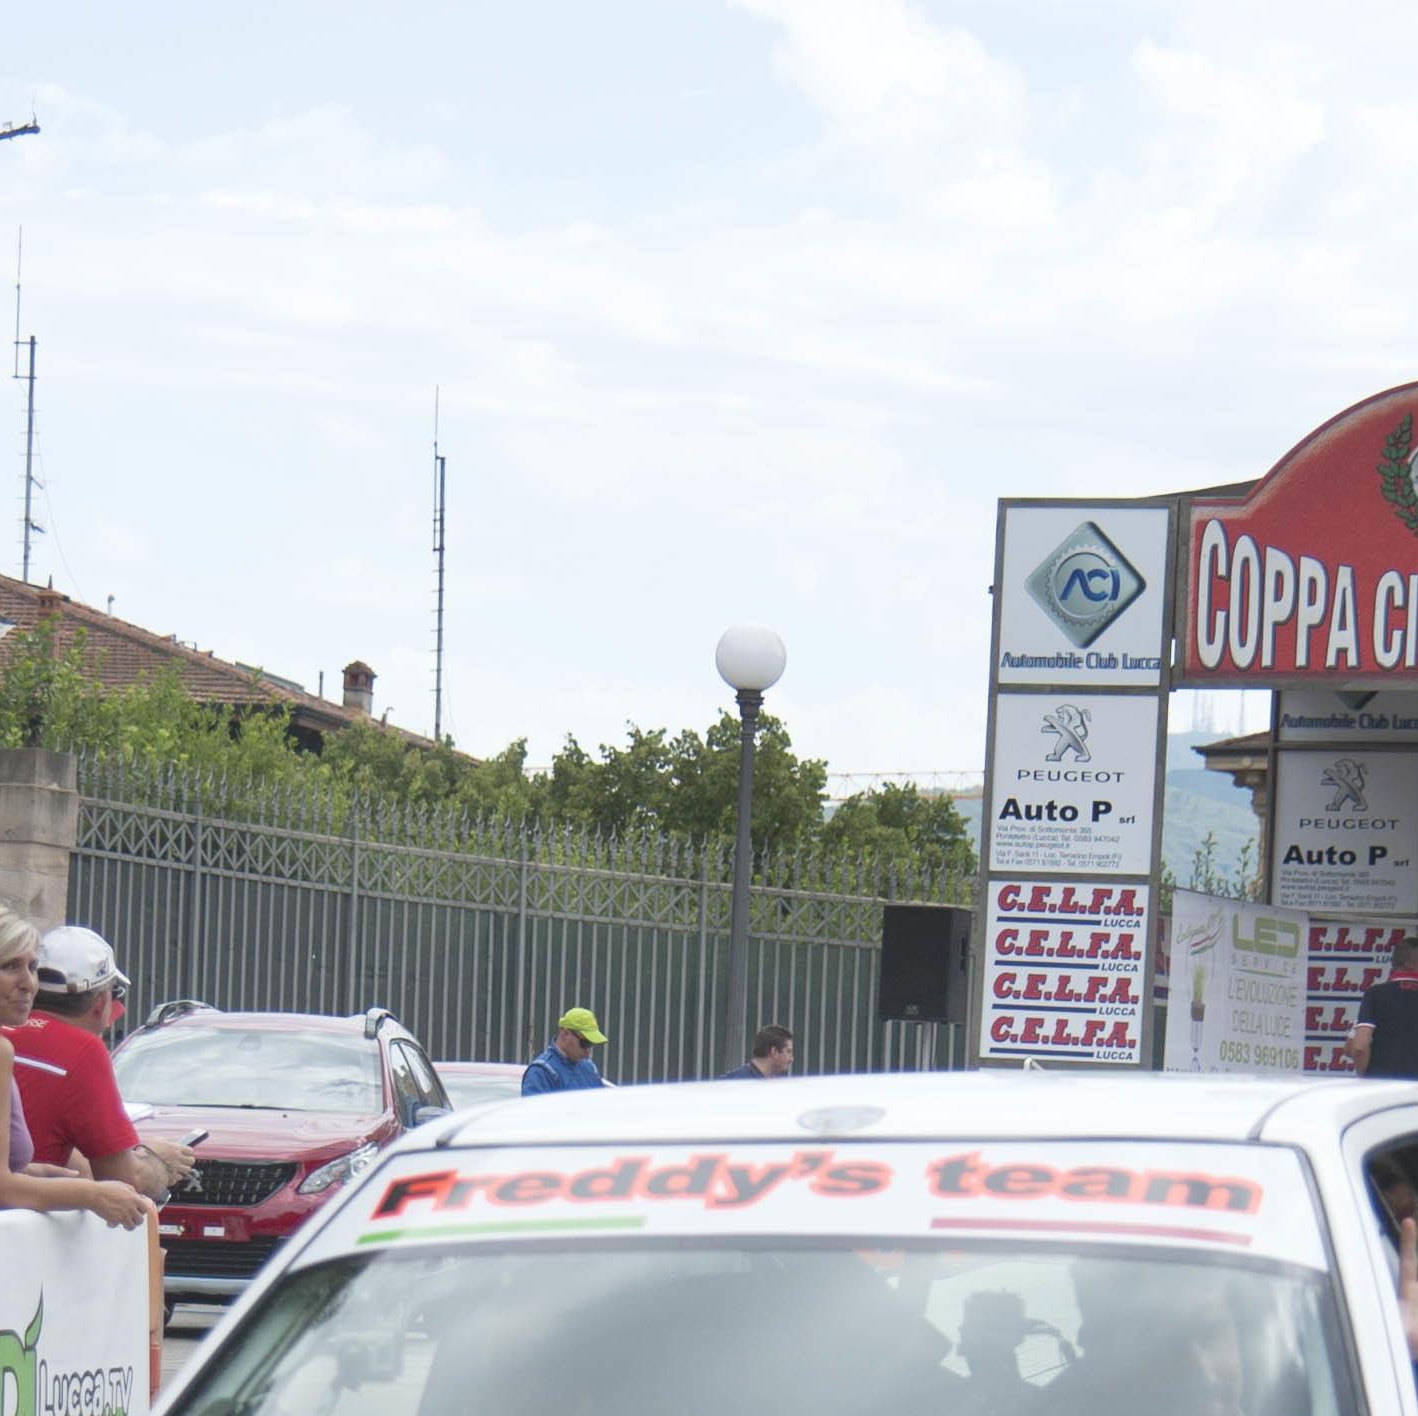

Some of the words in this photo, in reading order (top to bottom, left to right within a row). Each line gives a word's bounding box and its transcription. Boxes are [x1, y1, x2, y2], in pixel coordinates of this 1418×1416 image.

[1058, 567, 1121, 603] ACI
[1196, 518, 1361, 671] COPPA
[1000, 651, 1083, 671] Automobile
[1085, 651, 1119, 671] Club
[1121, 652, 1162, 671] Lucca
[1280, 713, 1356, 730] Automobile
[1358, 714, 1390, 730] Club
[1017, 768, 1125, 784] PEUGEOT
[998, 798, 1079, 824] Auto
[1091, 799, 1113, 824] P
[1118, 813, 1136, 826] srl
[1298, 818, 1400, 831] PEUGEOT
[1282, 844, 1358, 867] Auto
[1367, 844, 1389, 867] P
[996, 884, 1145, 917] C.E.L.F.A.
[1102, 917, 1142, 929] LUCCA
[994, 928, 1143, 961] C.E.L.F.A.
[1100, 961, 1140, 973] LUCCA
[991, 971, 1140, 1005] C.E.L.F.A.
[1097, 1005, 1137, 1017] LUCCA
[989, 1015, 1137, 1049] C.E.L.F.A.
[1095, 1049, 1134, 1061] LUCCA
[1219, 1039, 1250, 1064] 0583
[371, 1148, 894, 1219] Freddy's
[926, 1149, 1263, 1216] team
